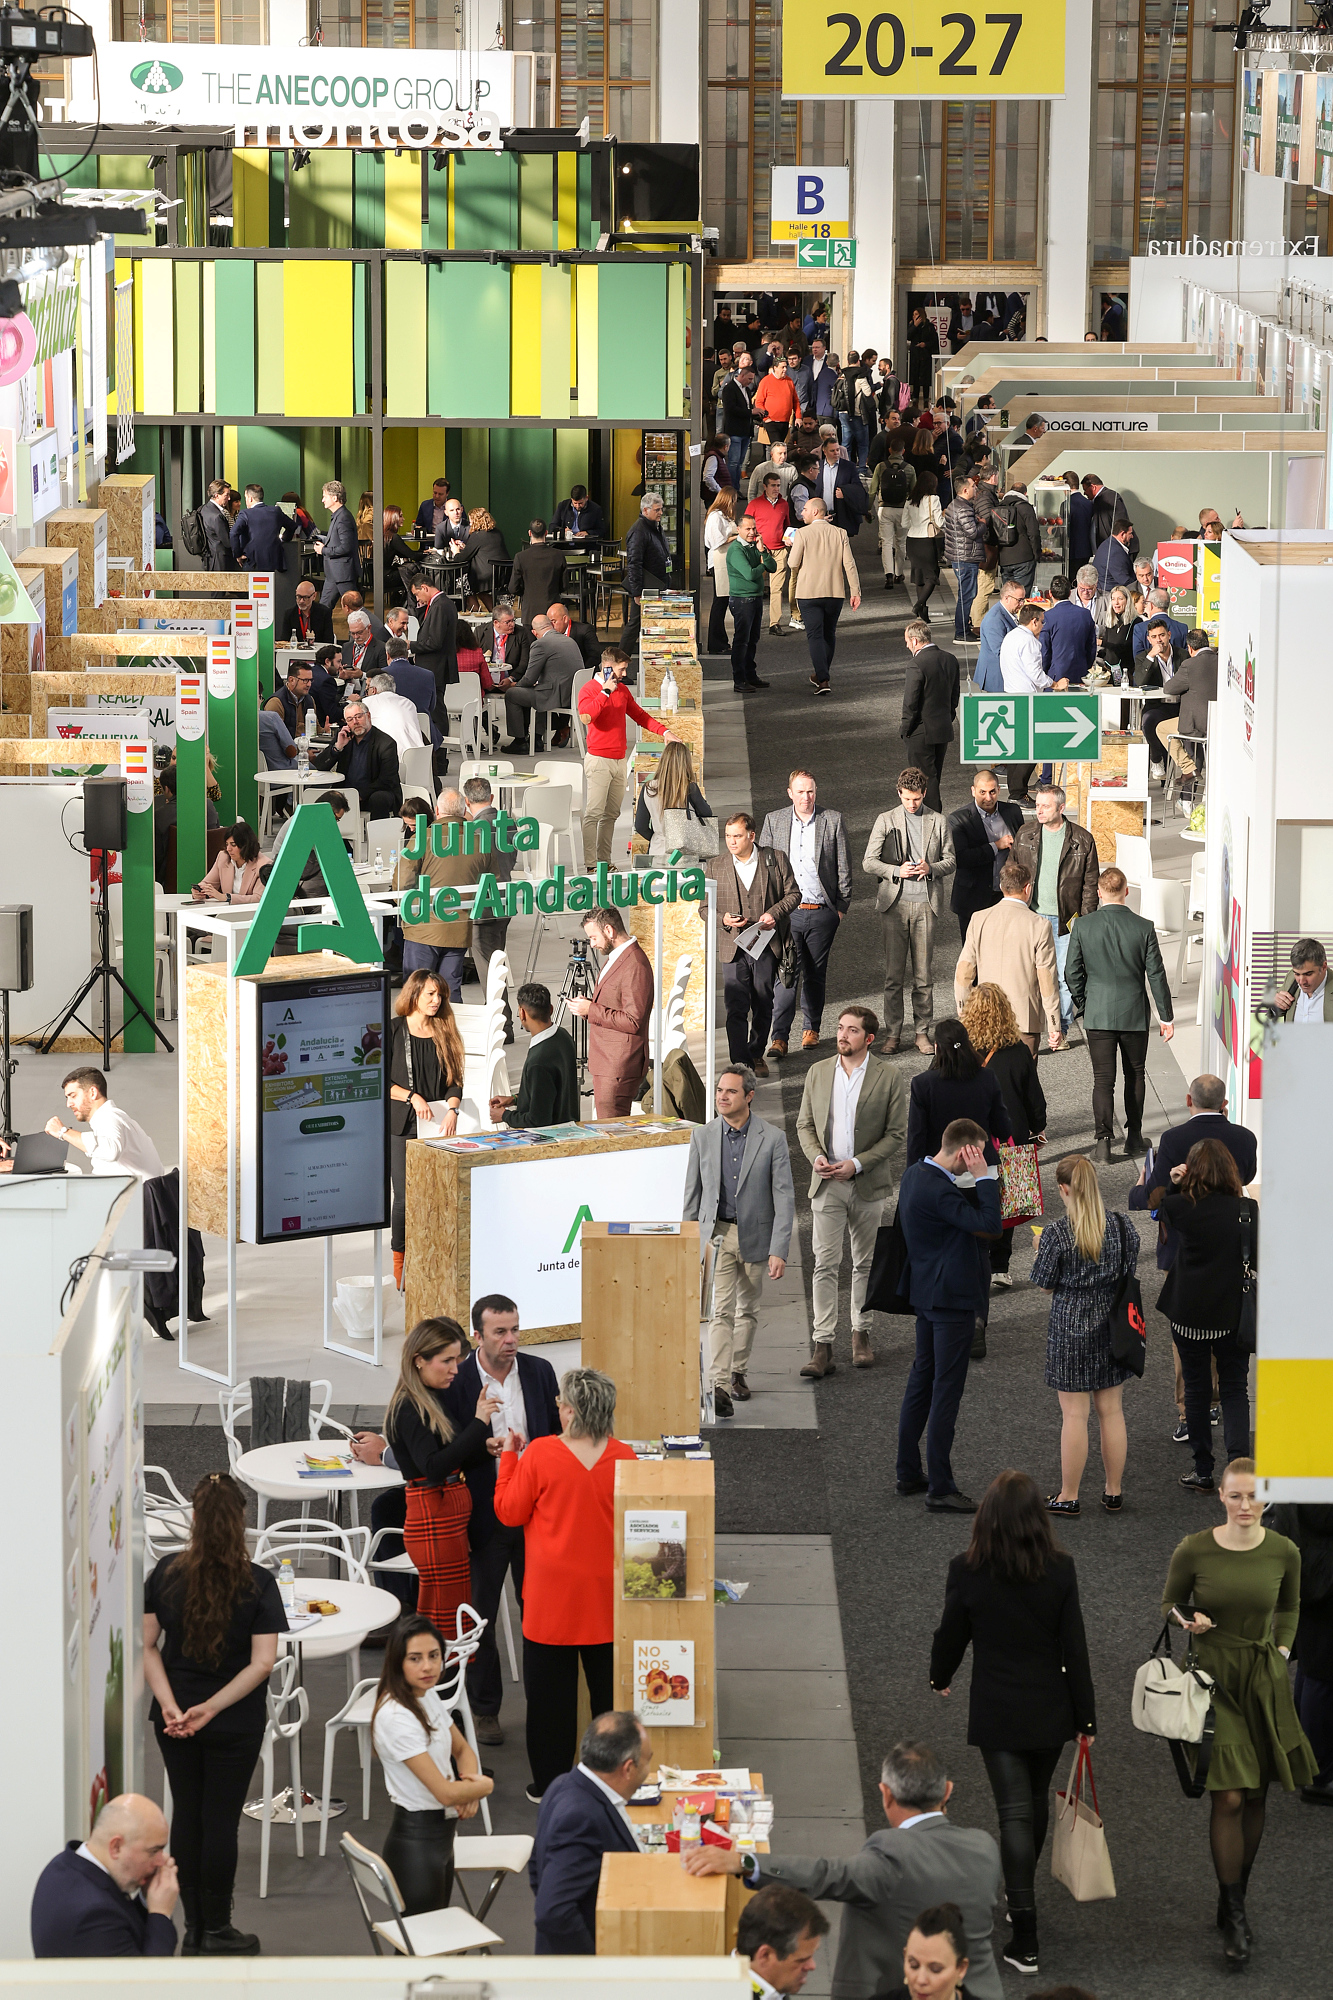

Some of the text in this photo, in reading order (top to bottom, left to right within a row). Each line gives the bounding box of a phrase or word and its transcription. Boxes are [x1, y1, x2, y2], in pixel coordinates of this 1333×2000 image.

[825, 13, 1022, 76] 20-27
[202, 72, 491, 112] THE ANECOOP GROUP
[797, 175, 825, 215] B
[811, 224, 831, 238] 18
[939, 316, 948, 348] GUIDE
[400, 810, 540, 861] Junta
[400, 849, 706, 925] de Andalucía
[537, 1258, 580, 1272] Junta de
[638, 1646, 660, 1657] NO
[638, 1660, 670, 1671] NOS
